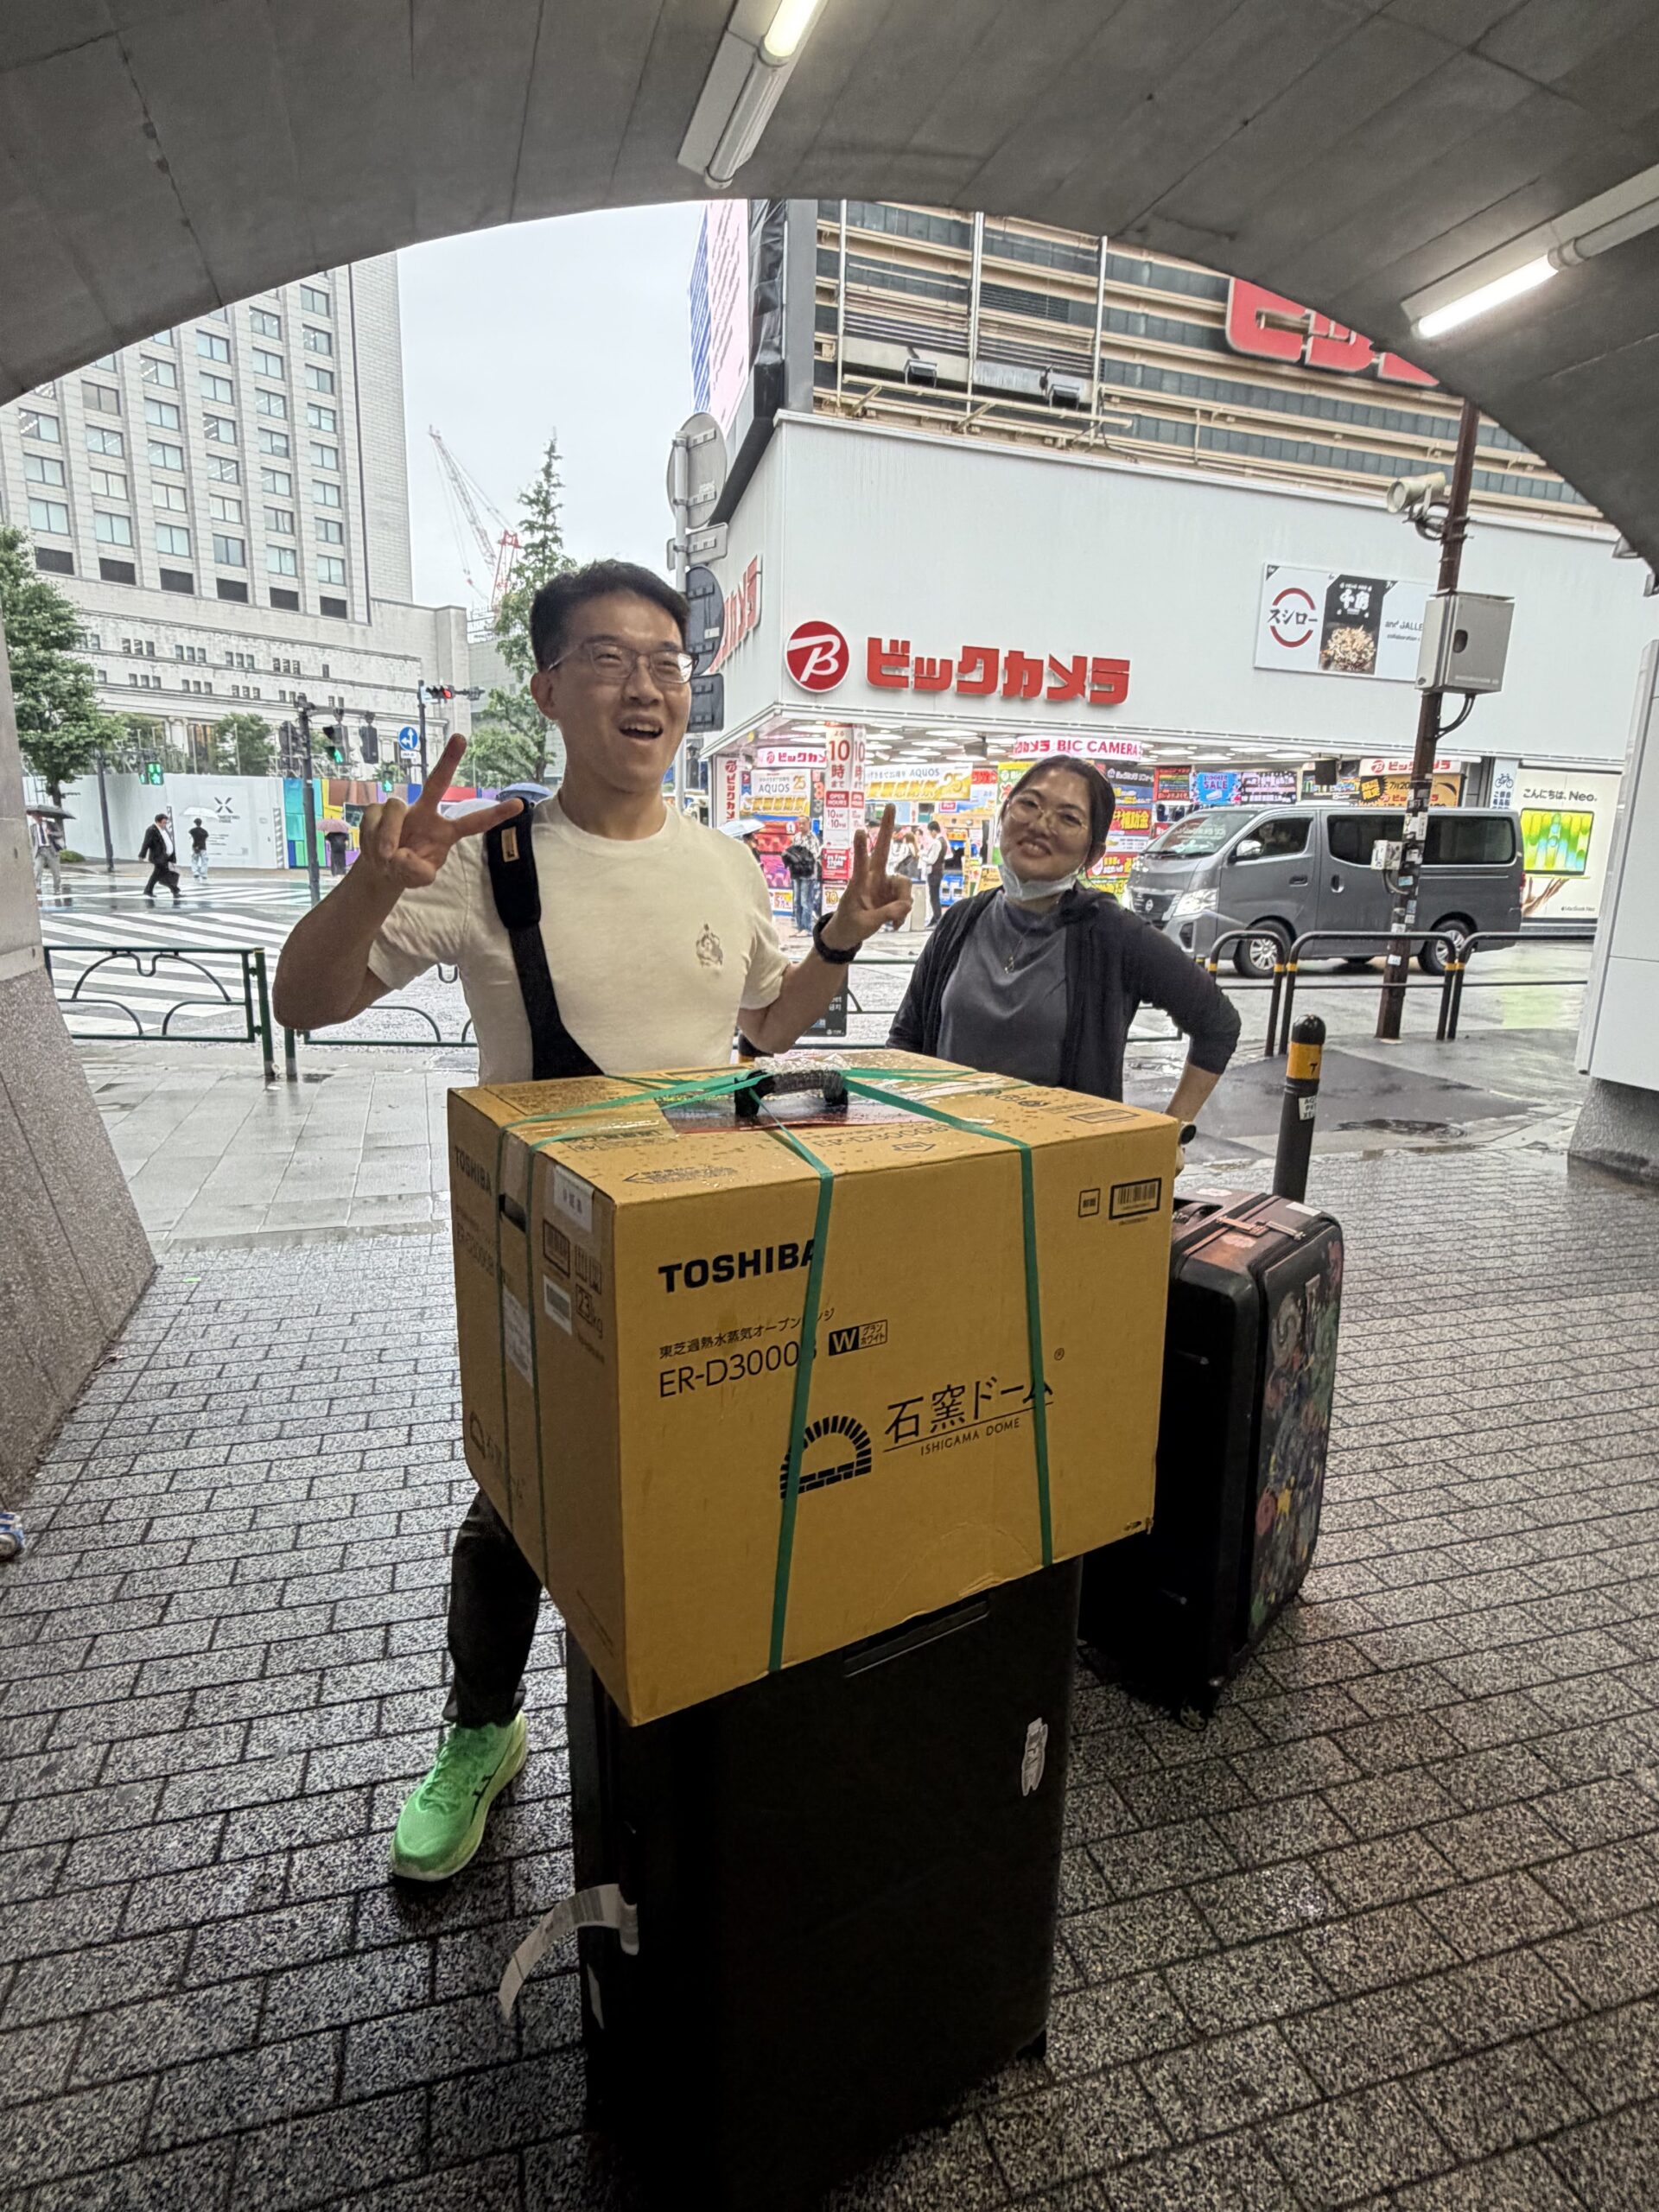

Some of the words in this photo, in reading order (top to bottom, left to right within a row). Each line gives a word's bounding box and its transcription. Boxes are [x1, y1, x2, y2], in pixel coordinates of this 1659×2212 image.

[1268, 607, 1318, 626] スシロー
[865, 636, 1131, 705] ビックカメラ
[830, 740, 850, 761] 10
[1057, 740, 1083, 752] BIC
[1087, 741, 1138, 756] CAMERA
[831, 764, 844, 778] 時
[910, 767, 940, 778] AQUOS
[759, 784, 790, 793] AQUOS
[1204, 780, 1228, 790] SALE
[1568, 791, 1598, 802] Neo.
[832, 1328, 858, 1353] W
[660, 1340, 817, 1398] ER-D3000
[885, 1376, 1053, 1444] 石窯ドーム
[920, 1429, 980, 1456] ISHIGAMA
[986, 1417, 1020, 1436] DOME
